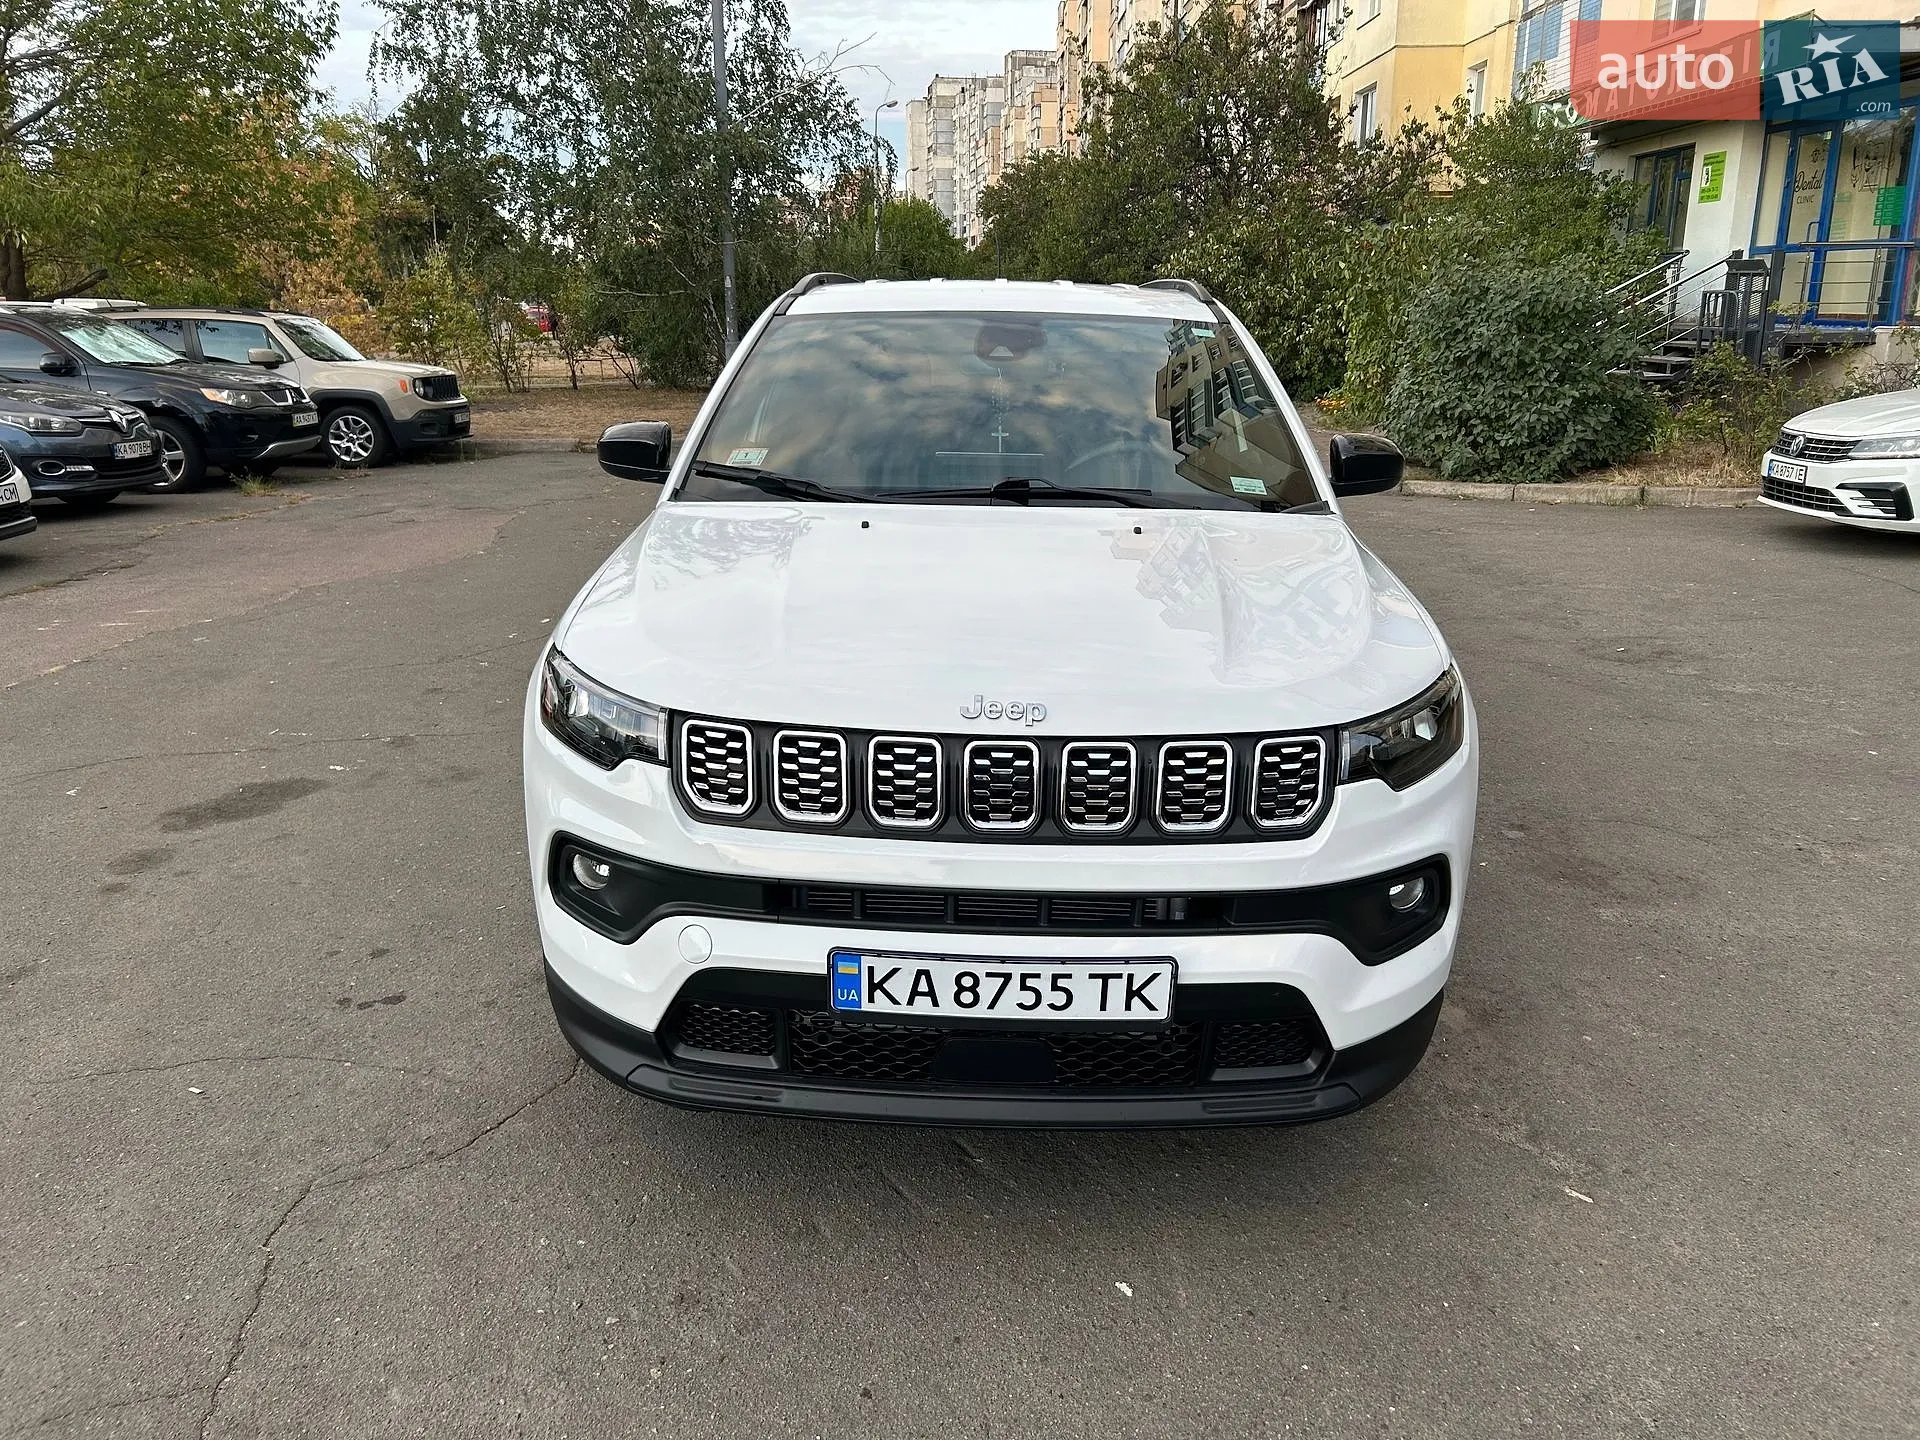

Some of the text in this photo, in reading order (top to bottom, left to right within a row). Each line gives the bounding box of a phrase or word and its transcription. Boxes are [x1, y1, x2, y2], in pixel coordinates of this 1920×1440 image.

[1794, 167, 1826, 193] Dental
[117, 442, 151, 456] KA 9078 BH
[1779, 464, 1795, 479] 8757
[1794, 467, 1804, 482] IE
[3, 487, 17, 500] CM
[960, 694, 1047, 727] Jeep
[837, 988, 859, 1002] UA
[866, 965, 1163, 1012] KA 8755 TK
